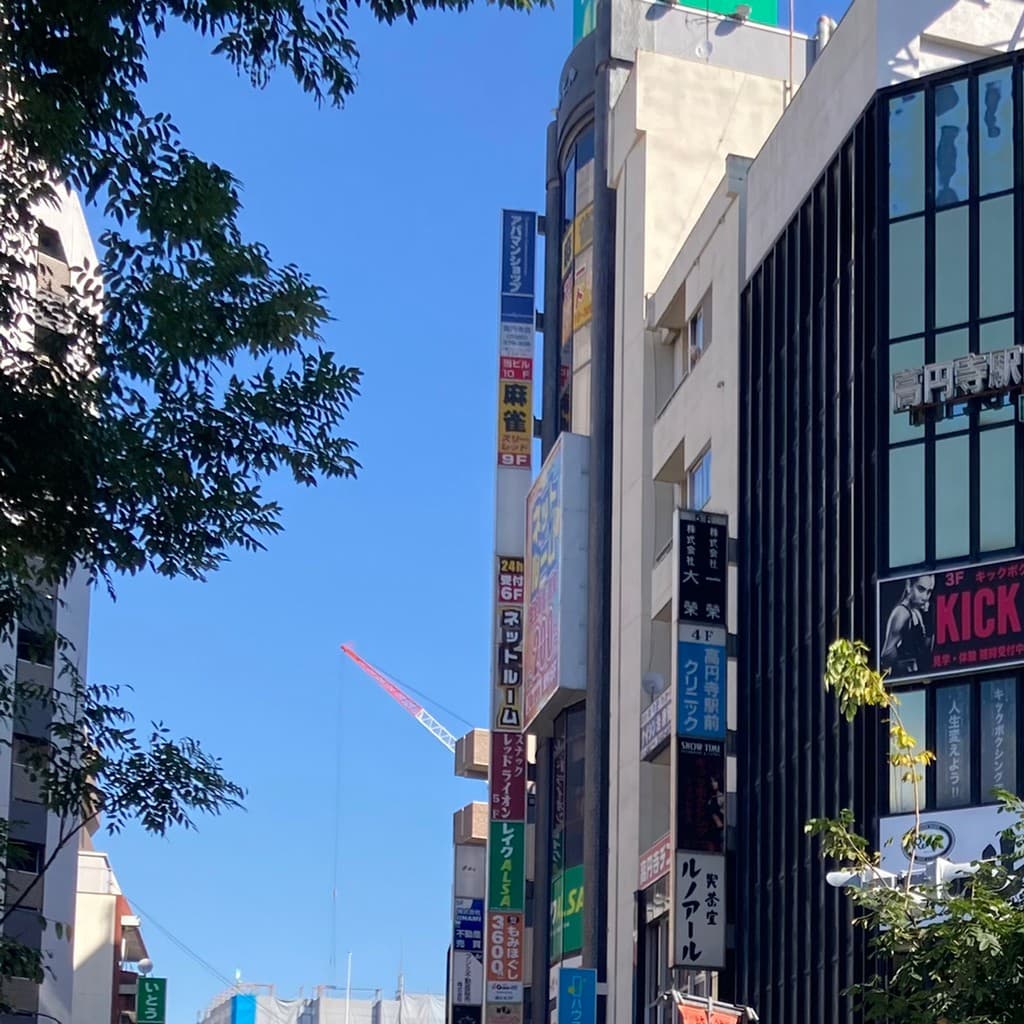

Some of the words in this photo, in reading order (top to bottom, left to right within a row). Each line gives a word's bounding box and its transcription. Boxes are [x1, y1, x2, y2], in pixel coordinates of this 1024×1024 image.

[503, 383, 527, 432] 麻雀
[501, 455, 527, 465] 9F
[501, 588, 523, 600] 6F
[945, 571, 964, 586] 3F
[936, 584, 1022, 644] KICK
[501, 609, 521, 726] ネットルーム
[704, 648, 719, 732] 高円寺駅前
[683, 659, 698, 731] クリニック
[993, 688, 1005, 787] キックボクシング
[682, 858, 701, 962] ルノアール
[705, 872, 719, 926] 喫茶室
[507, 926, 520, 980] もみほぐし
[145, 982, 159, 1019] いとう
